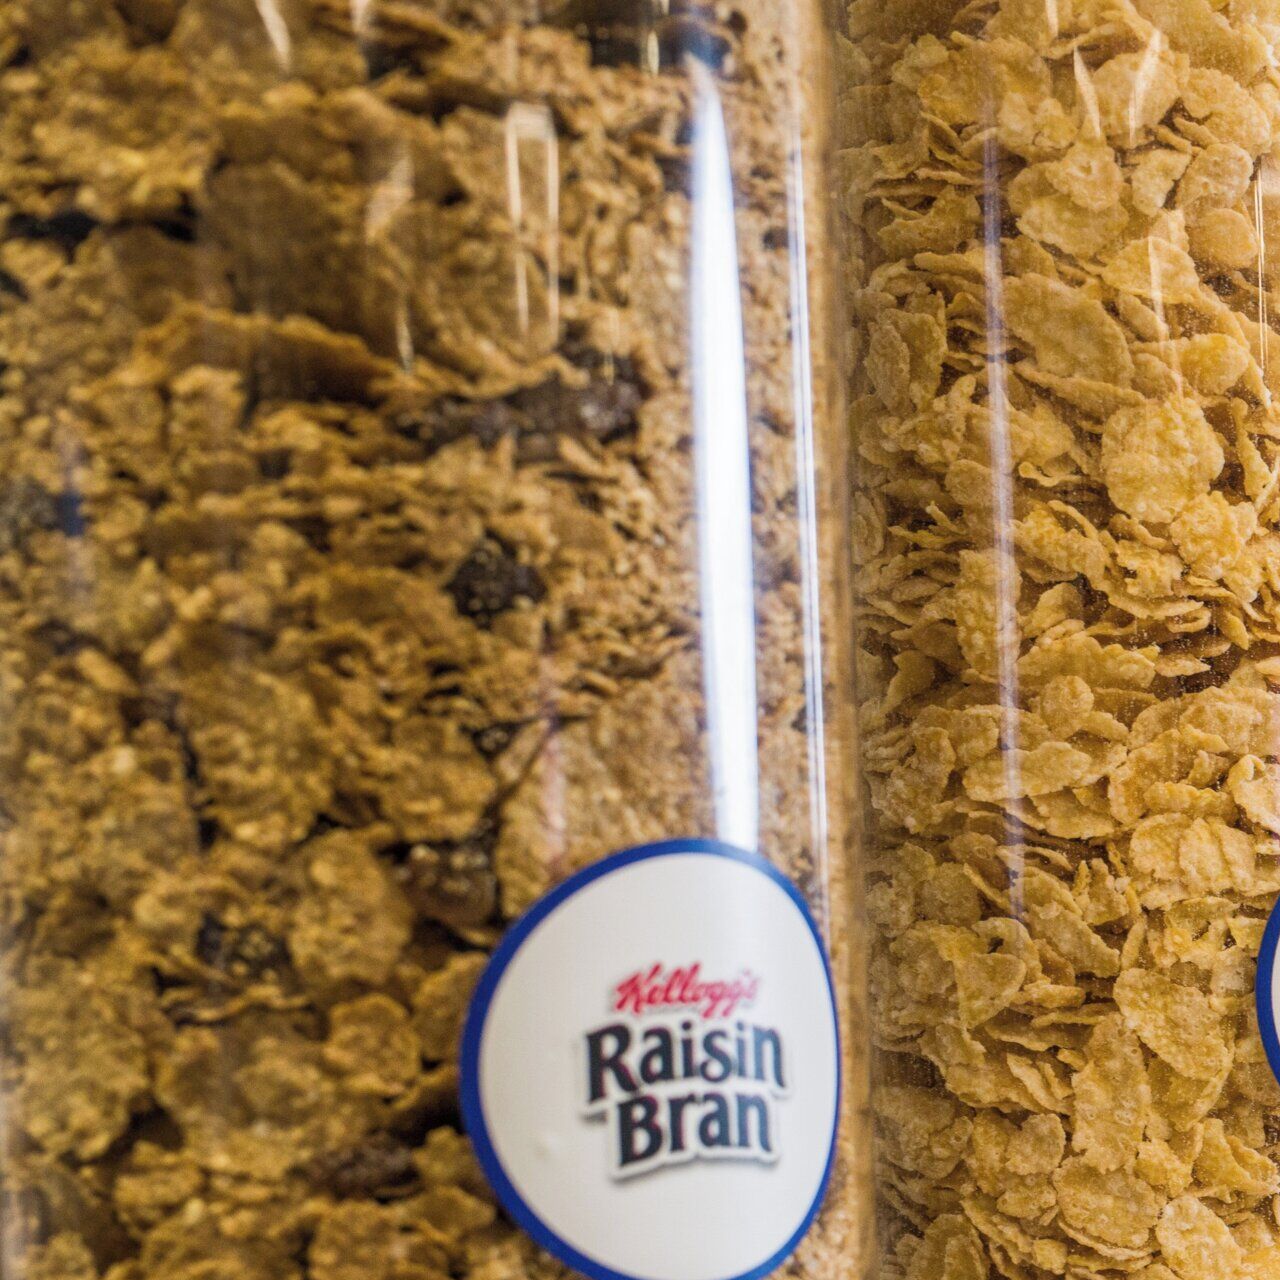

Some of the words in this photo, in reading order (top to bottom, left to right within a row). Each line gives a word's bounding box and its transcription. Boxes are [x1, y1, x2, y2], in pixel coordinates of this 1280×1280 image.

[614, 961, 758, 1018] Kellogg's
[586, 1021, 786, 1103] Raisin
[617, 1092, 772, 1167] Bran
